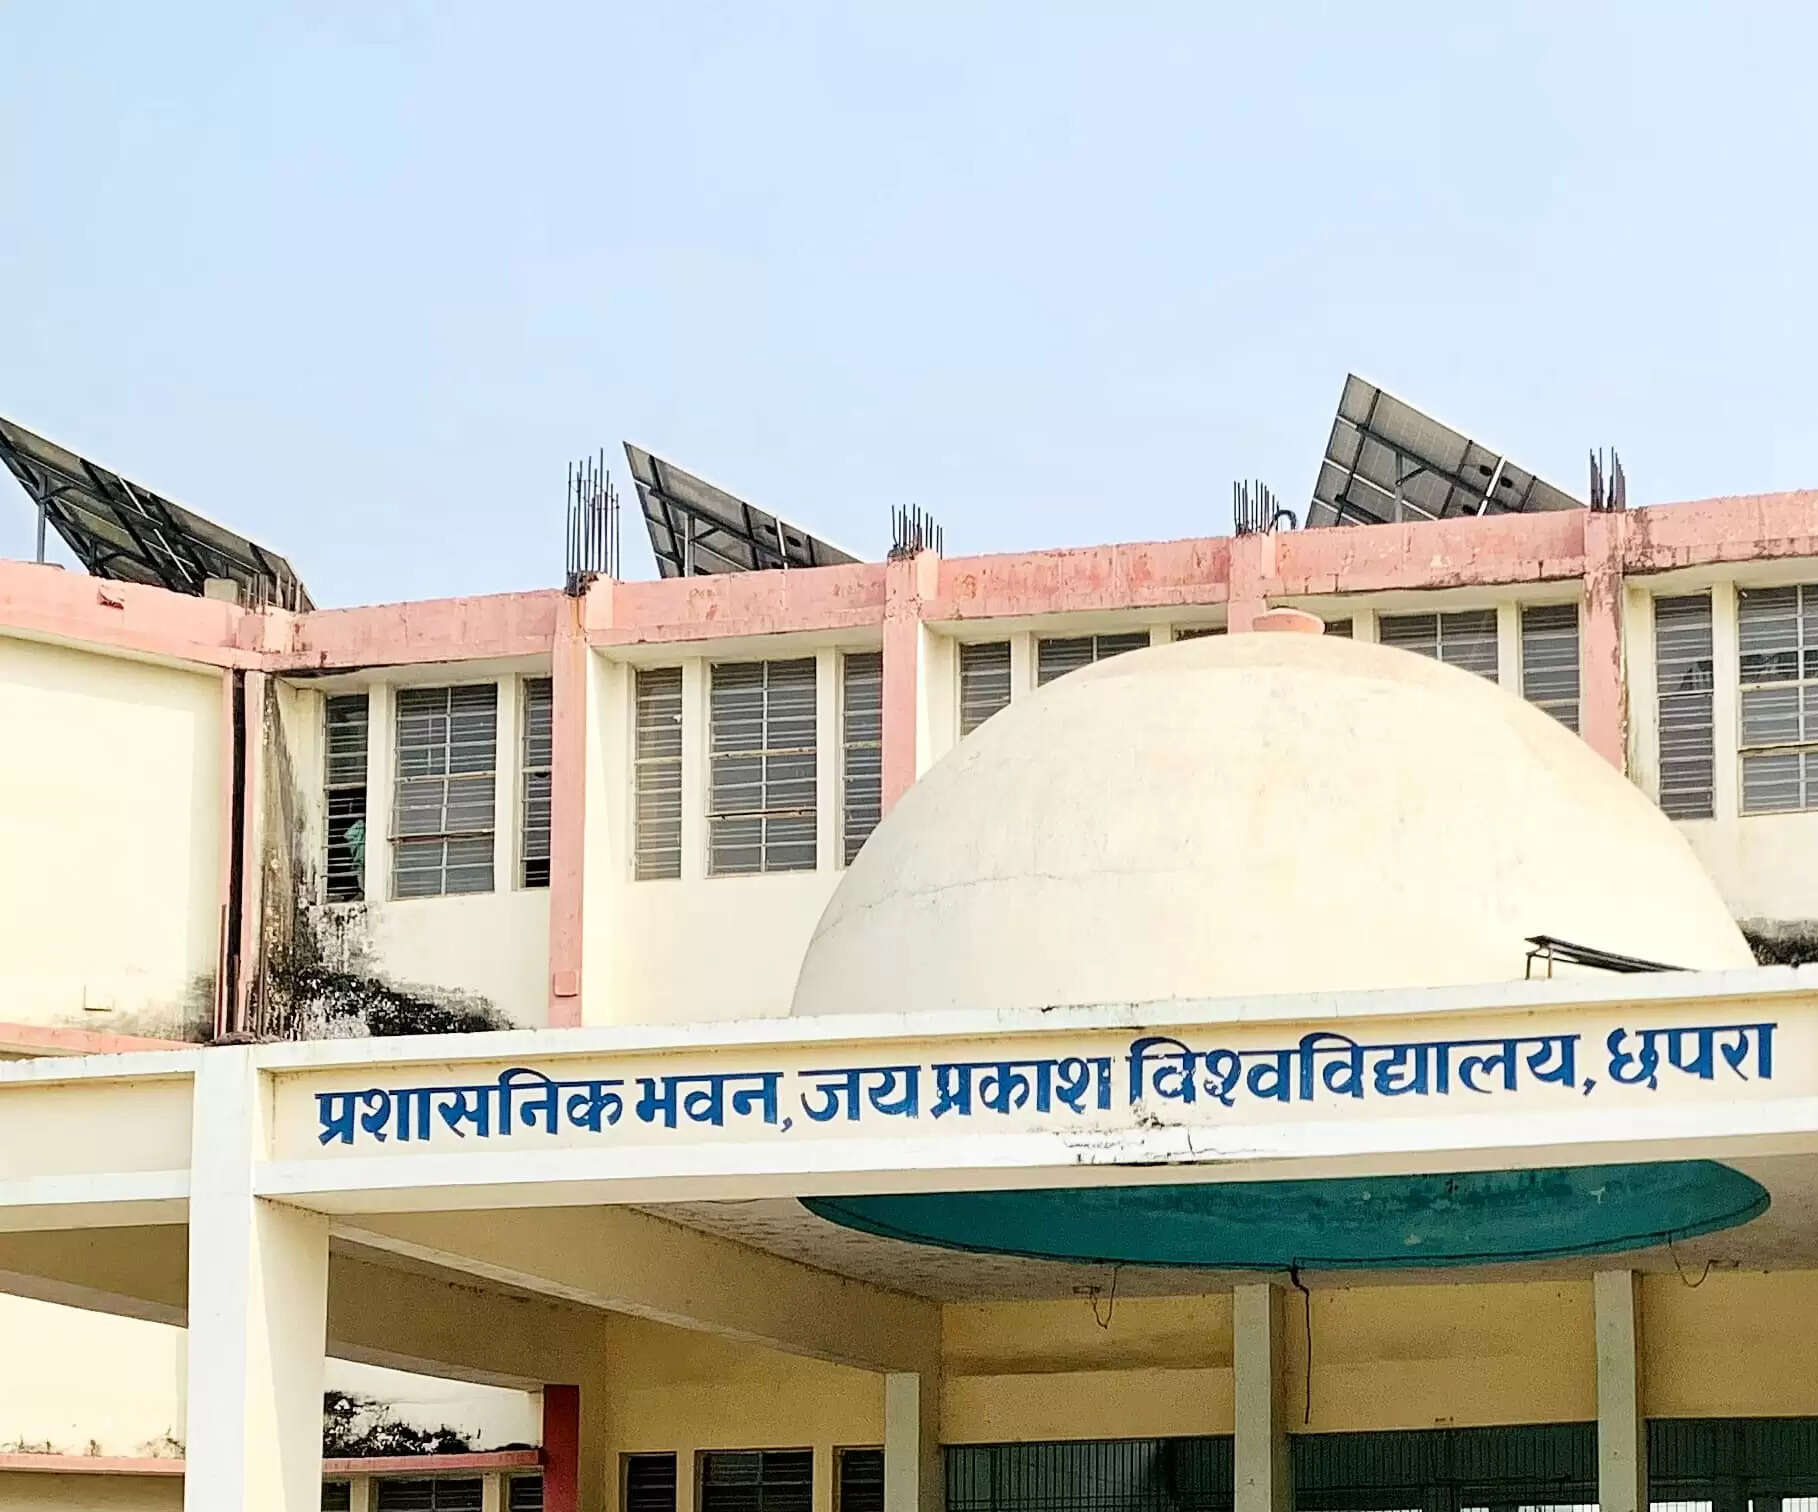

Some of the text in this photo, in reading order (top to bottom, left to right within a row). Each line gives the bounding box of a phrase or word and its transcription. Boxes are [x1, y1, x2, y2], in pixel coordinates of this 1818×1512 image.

[314, 1068, 625, 1147] प्रशासनिक
[635, 1072, 794, 1133] भवन,
[797, 1064, 922, 1122] जय
[930, 1055, 1112, 1118] प्रकाश
[1606, 1022, 1778, 1089] छपरा
